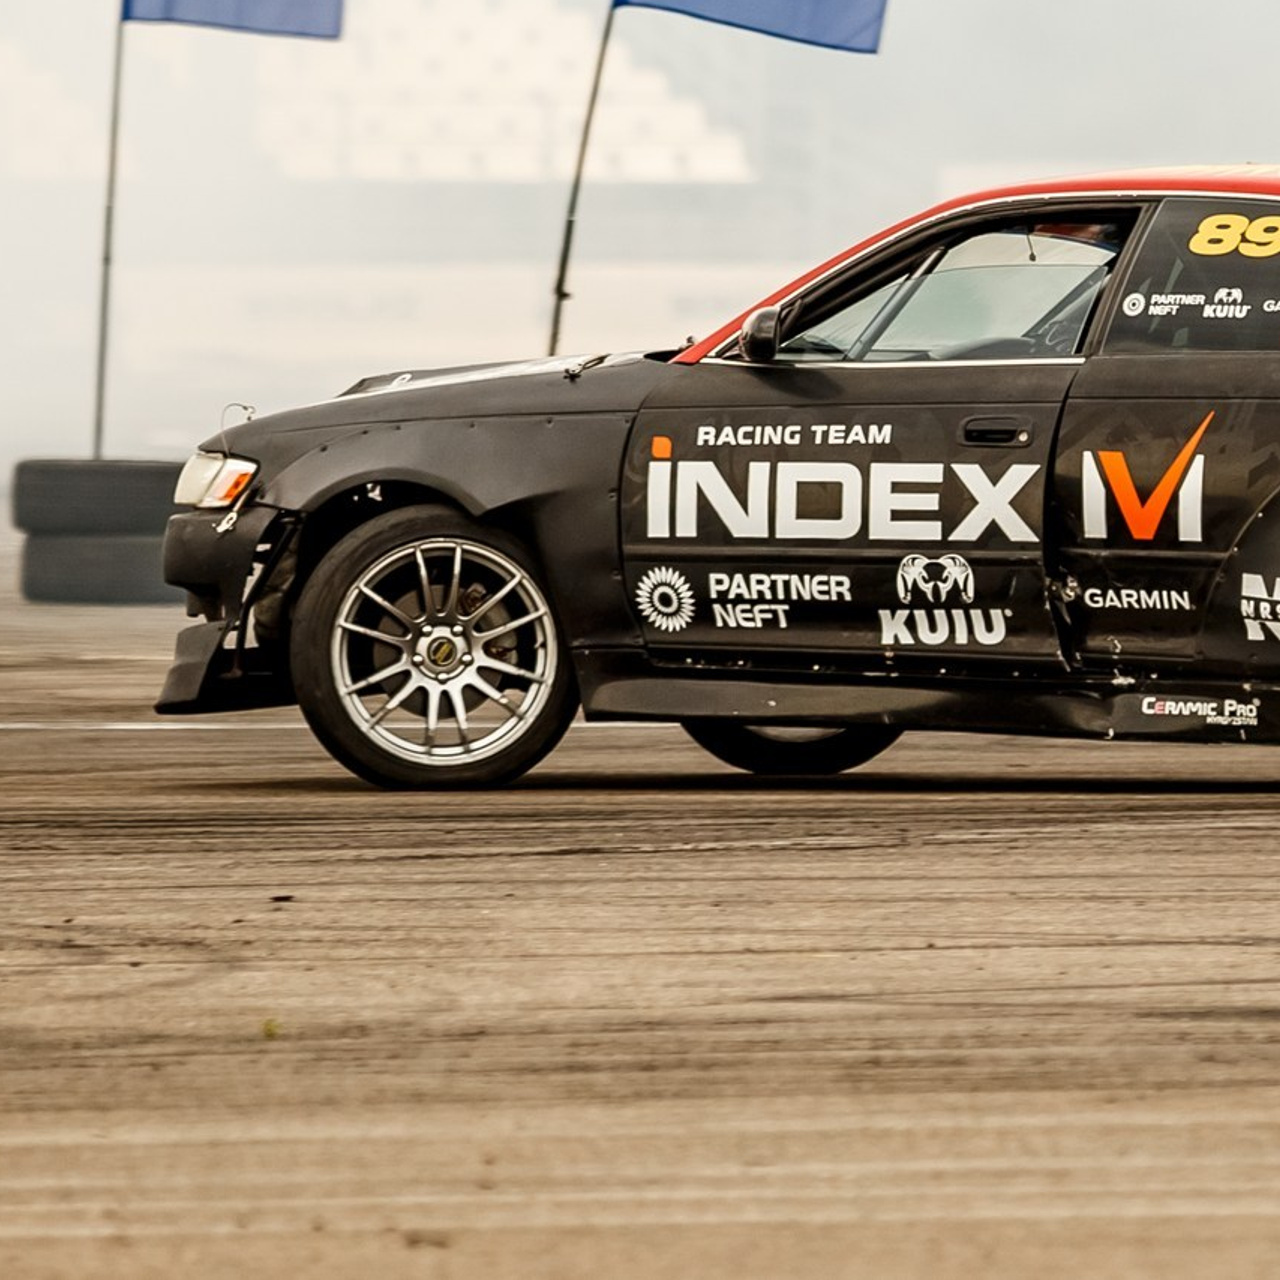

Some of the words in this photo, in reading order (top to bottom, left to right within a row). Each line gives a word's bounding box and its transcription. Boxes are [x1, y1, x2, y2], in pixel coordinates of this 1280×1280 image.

[1148, 305, 1180, 316] NEFT
[1150, 294, 1206, 305] PARTNER
[1202, 304, 1251, 319] KUIU
[696, 425, 801, 446] RACING
[811, 424, 893, 445] TEAM
[708, 573, 852, 602] PARTNER
[713, 603, 790, 629] NEFT
[878, 609, 1007, 646] KUIU
